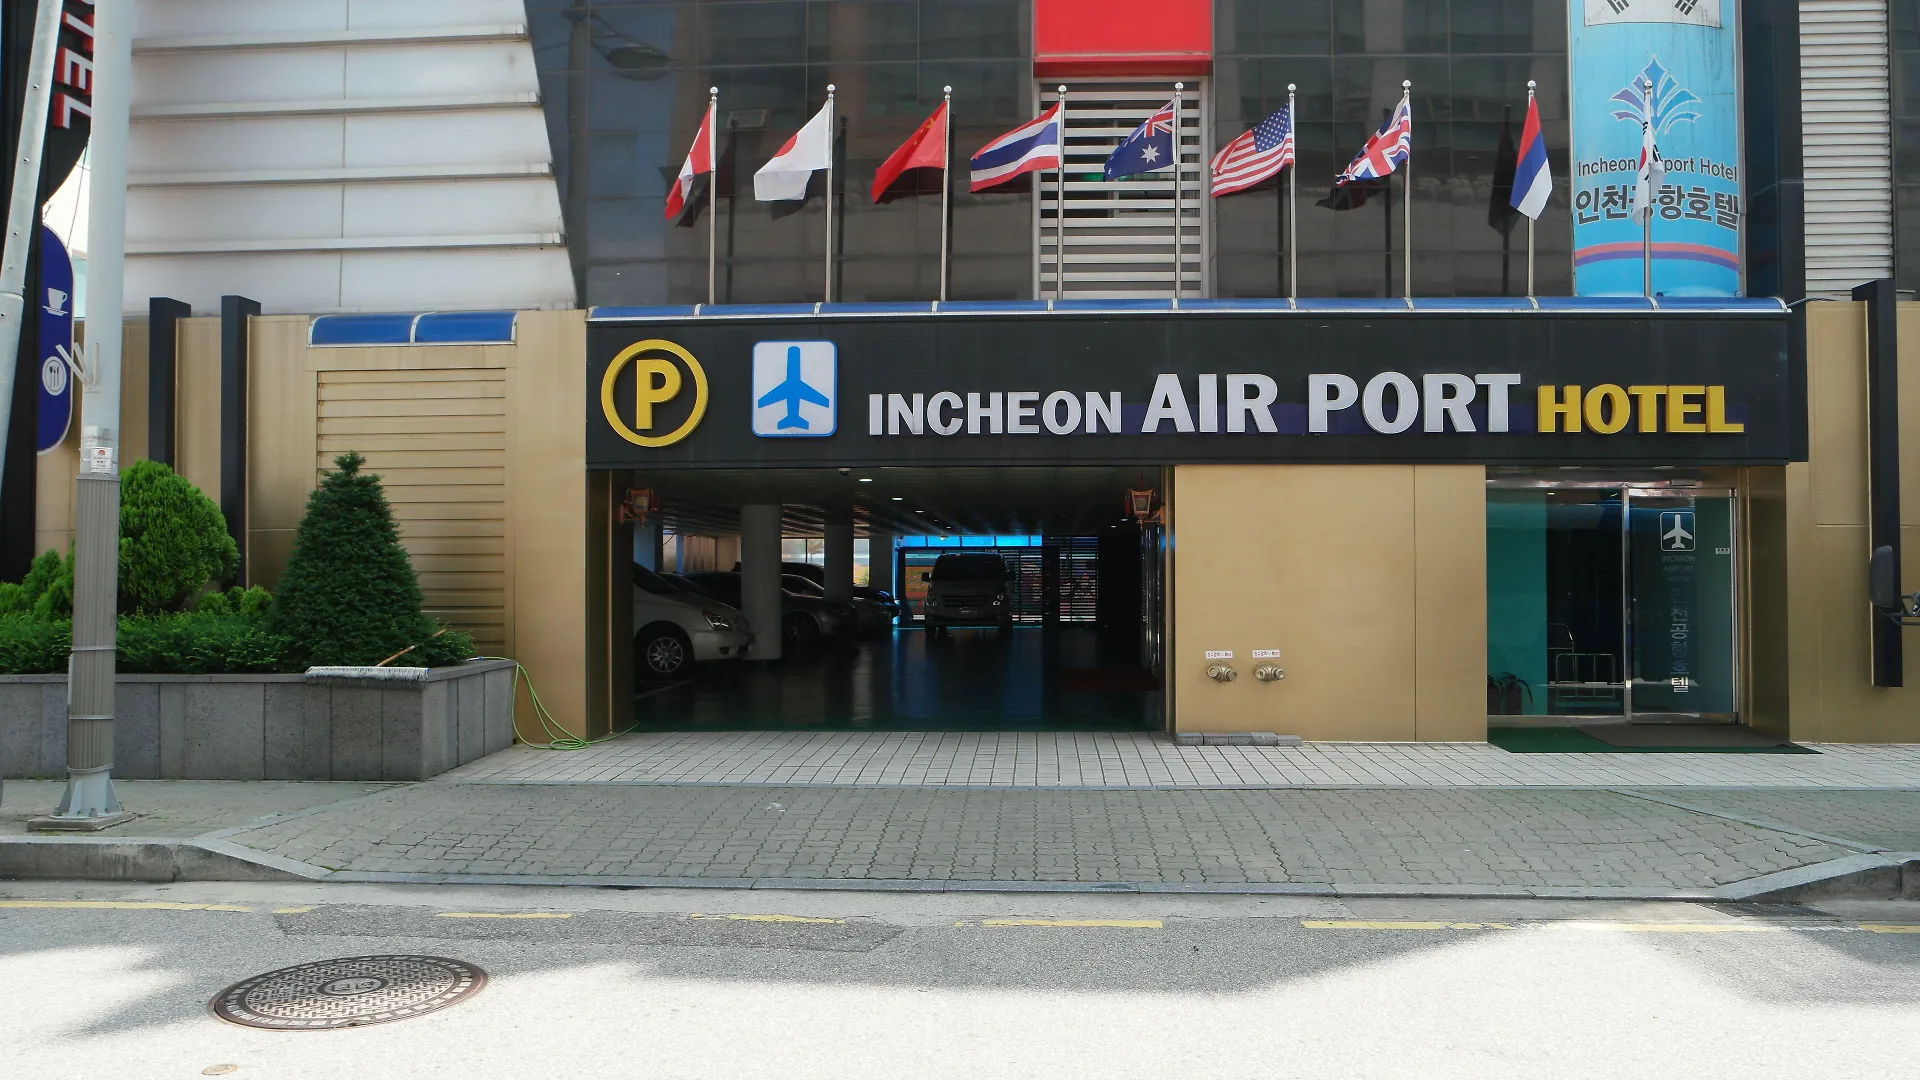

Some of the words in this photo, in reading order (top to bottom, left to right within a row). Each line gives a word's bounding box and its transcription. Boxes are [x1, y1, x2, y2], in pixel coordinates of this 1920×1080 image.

[1578, 157, 1637, 177] Incheon
[1700, 158, 1738, 182] Hotel
[636, 359, 682, 430] P
[869, 391, 1122, 436] INCHEON
[1141, 373, 1279, 434] AIR
[1308, 371, 1521, 434] PORT
[1537, 383, 1745, 434] HOTEL
[1661, 555, 1696, 563] INCHEON
